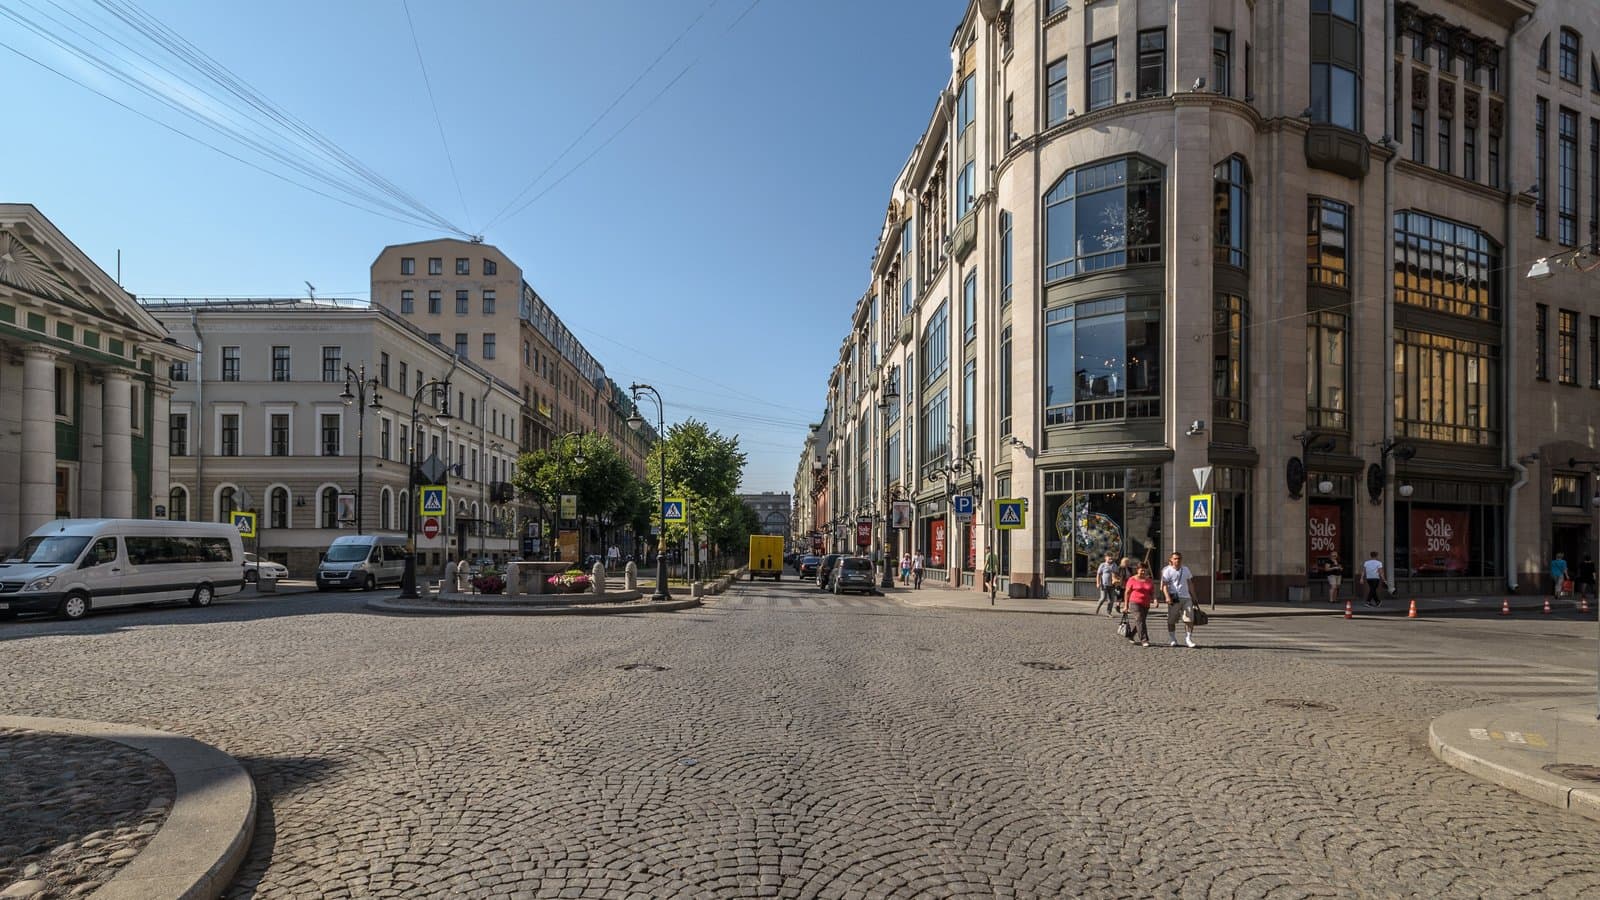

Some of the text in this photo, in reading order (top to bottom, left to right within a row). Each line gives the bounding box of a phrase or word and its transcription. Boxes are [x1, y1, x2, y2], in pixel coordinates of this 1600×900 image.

[1310, 517, 1336, 536] Sale
[1425, 517, 1453, 537] Sale
[1311, 534, 1335, 551] 50%
[1427, 537, 1450, 552] 50%
